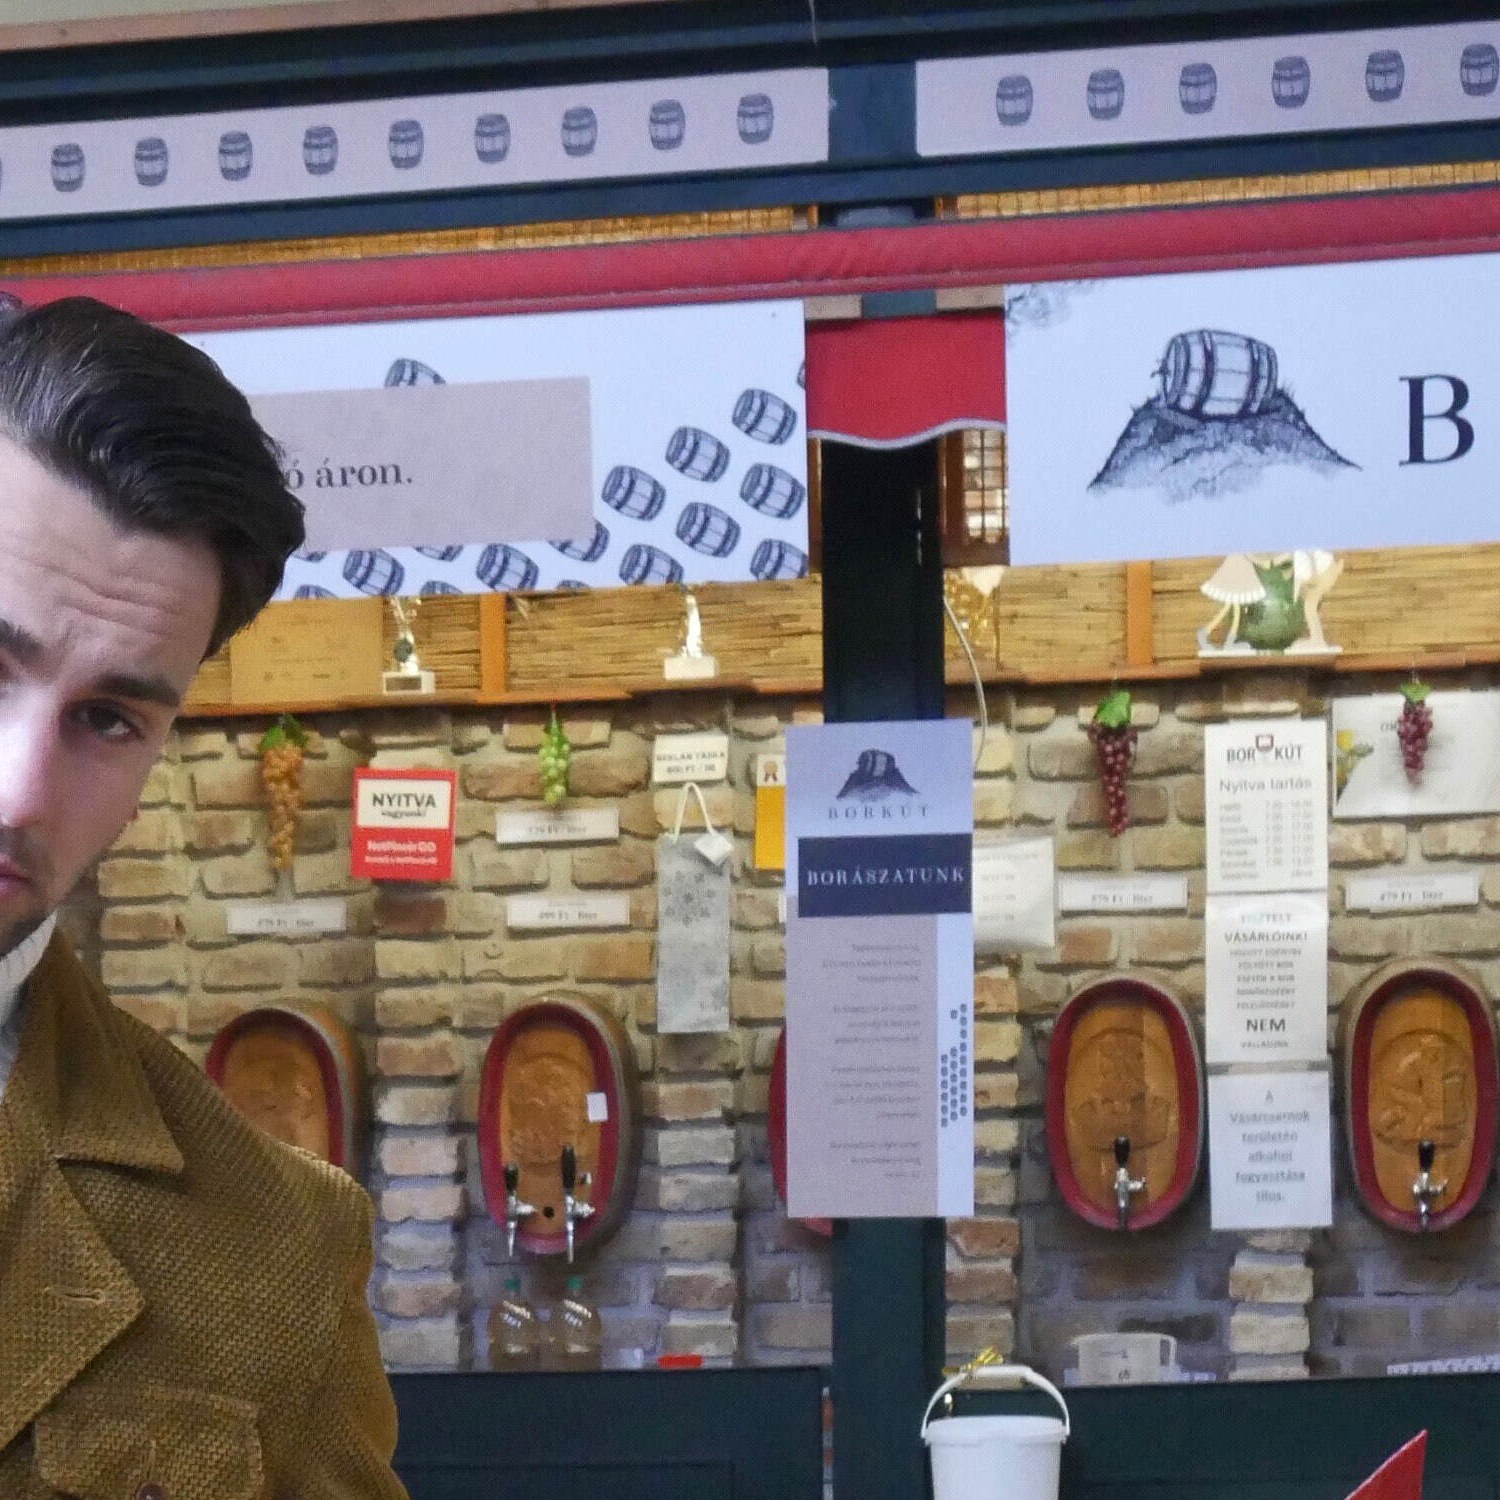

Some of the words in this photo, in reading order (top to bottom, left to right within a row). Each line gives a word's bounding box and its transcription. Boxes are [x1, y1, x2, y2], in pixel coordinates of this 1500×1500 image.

[1399, 374, 1475, 467] B
[316, 457, 412, 488] áron.
[1227, 746, 1256, 762] BOR
[371, 792, 437, 808] NYITVA
[806, 863, 965, 886] BORÁSZATUNK
[1246, 1018, 1286, 1032] NEM
